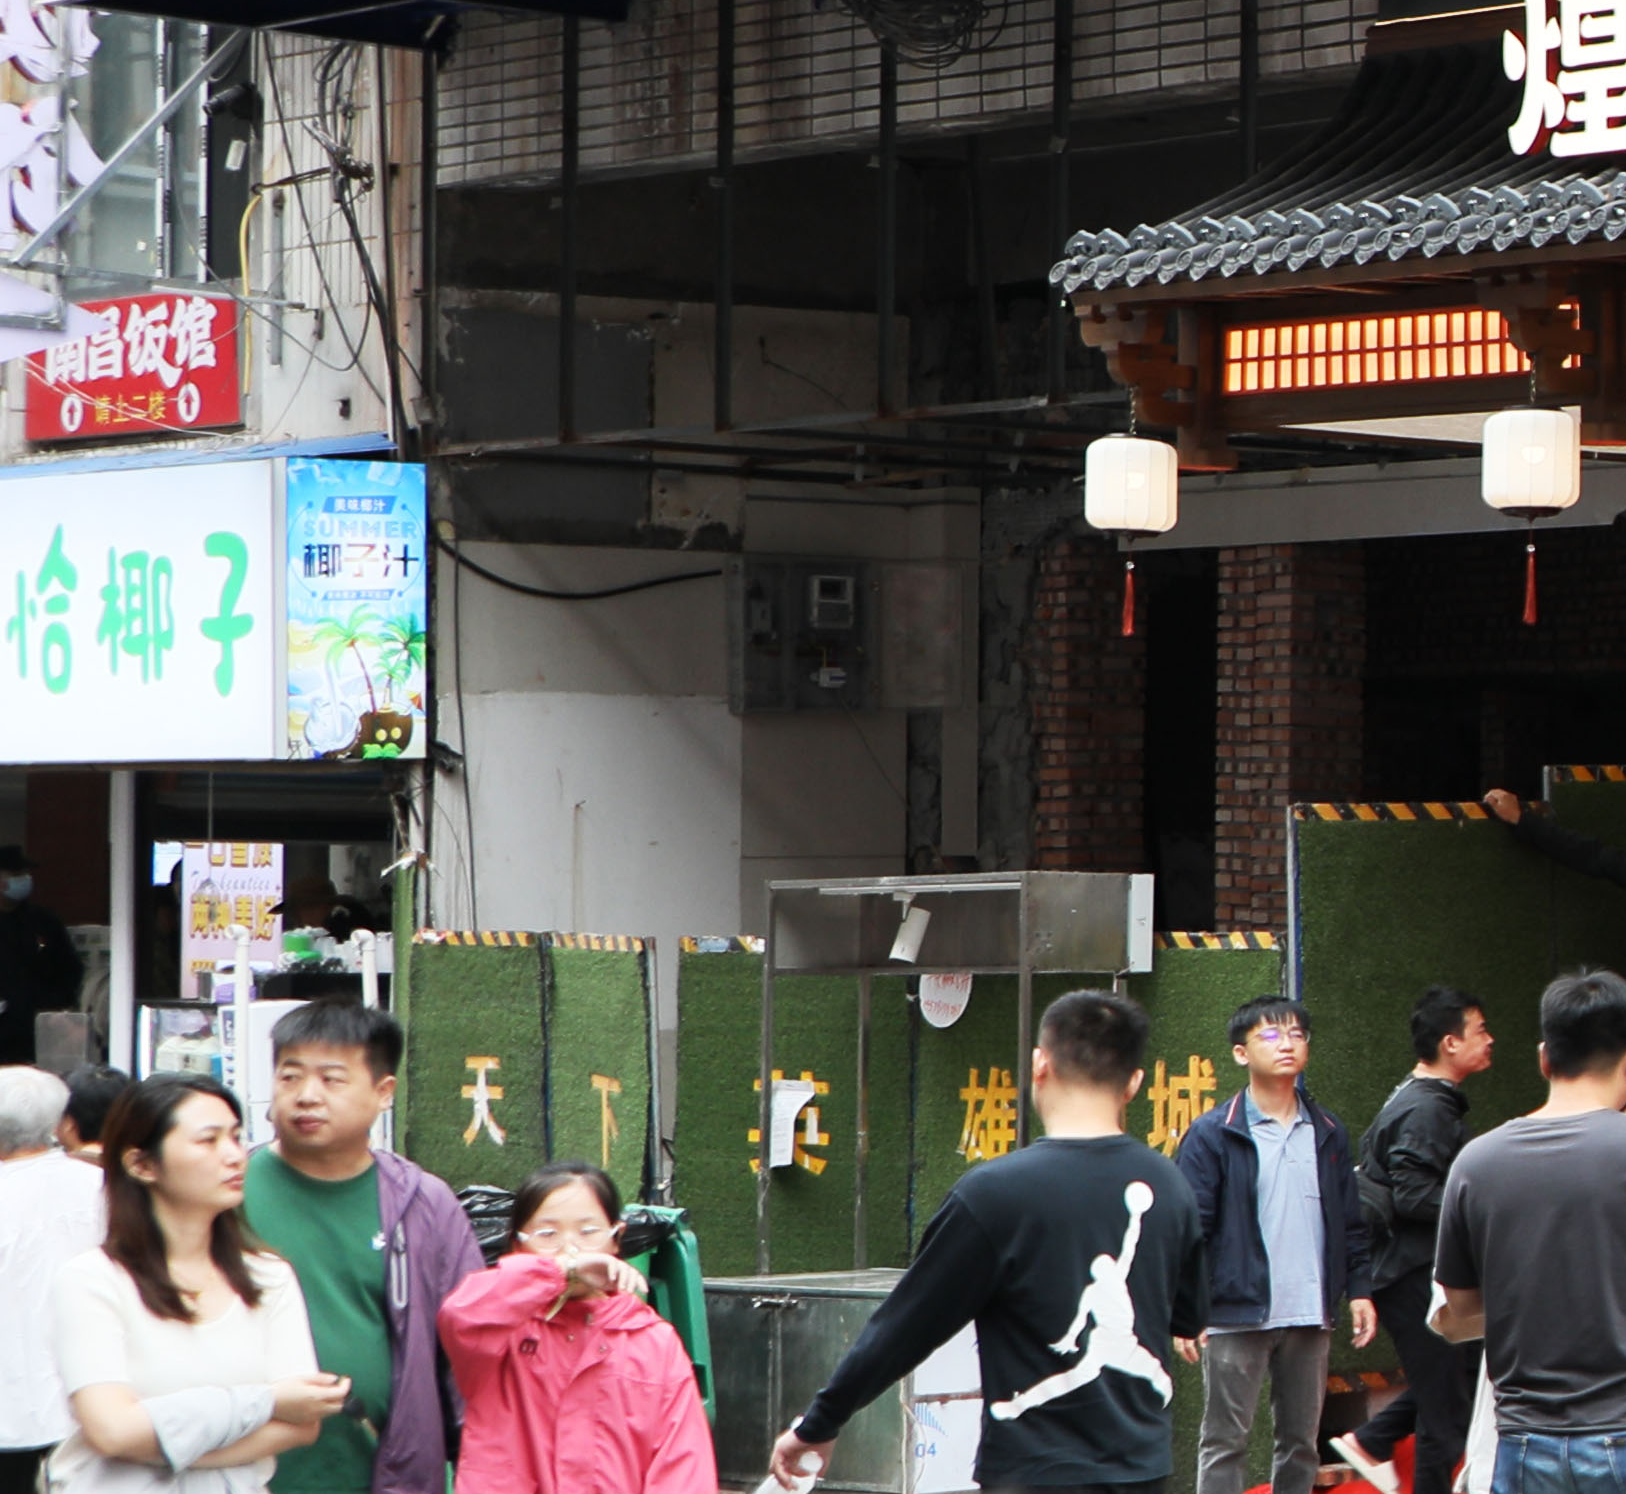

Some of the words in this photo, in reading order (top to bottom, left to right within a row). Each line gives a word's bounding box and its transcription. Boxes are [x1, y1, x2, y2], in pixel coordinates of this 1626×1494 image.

[303, 519, 418, 539] SUMMER
[303, 544, 420, 578] 椰子汁
[4, 523, 254, 699] 恰椰子
